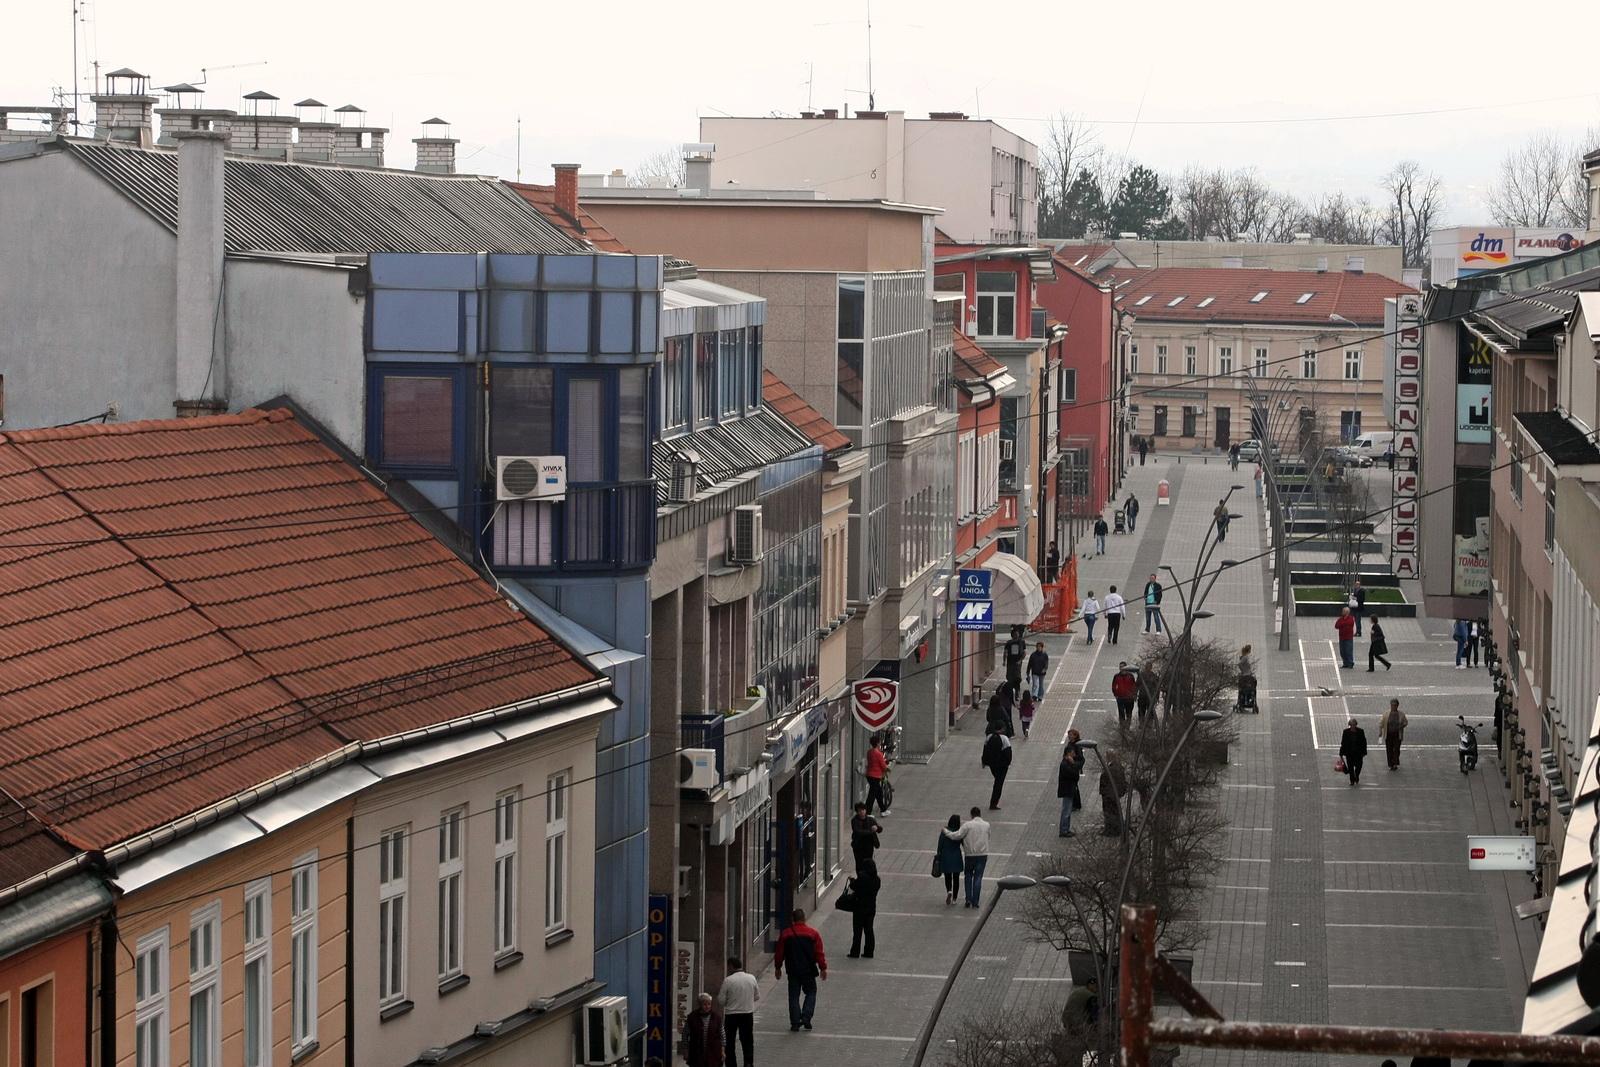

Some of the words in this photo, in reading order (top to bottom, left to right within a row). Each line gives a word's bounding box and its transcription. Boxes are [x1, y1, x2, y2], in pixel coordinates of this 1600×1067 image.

[1470, 233, 1503, 252] dm
[1399, 328, 1418, 452] ROBNA
[957, 602, 991, 620] MF
[648, 909, 664, 1040] OPTIKA
